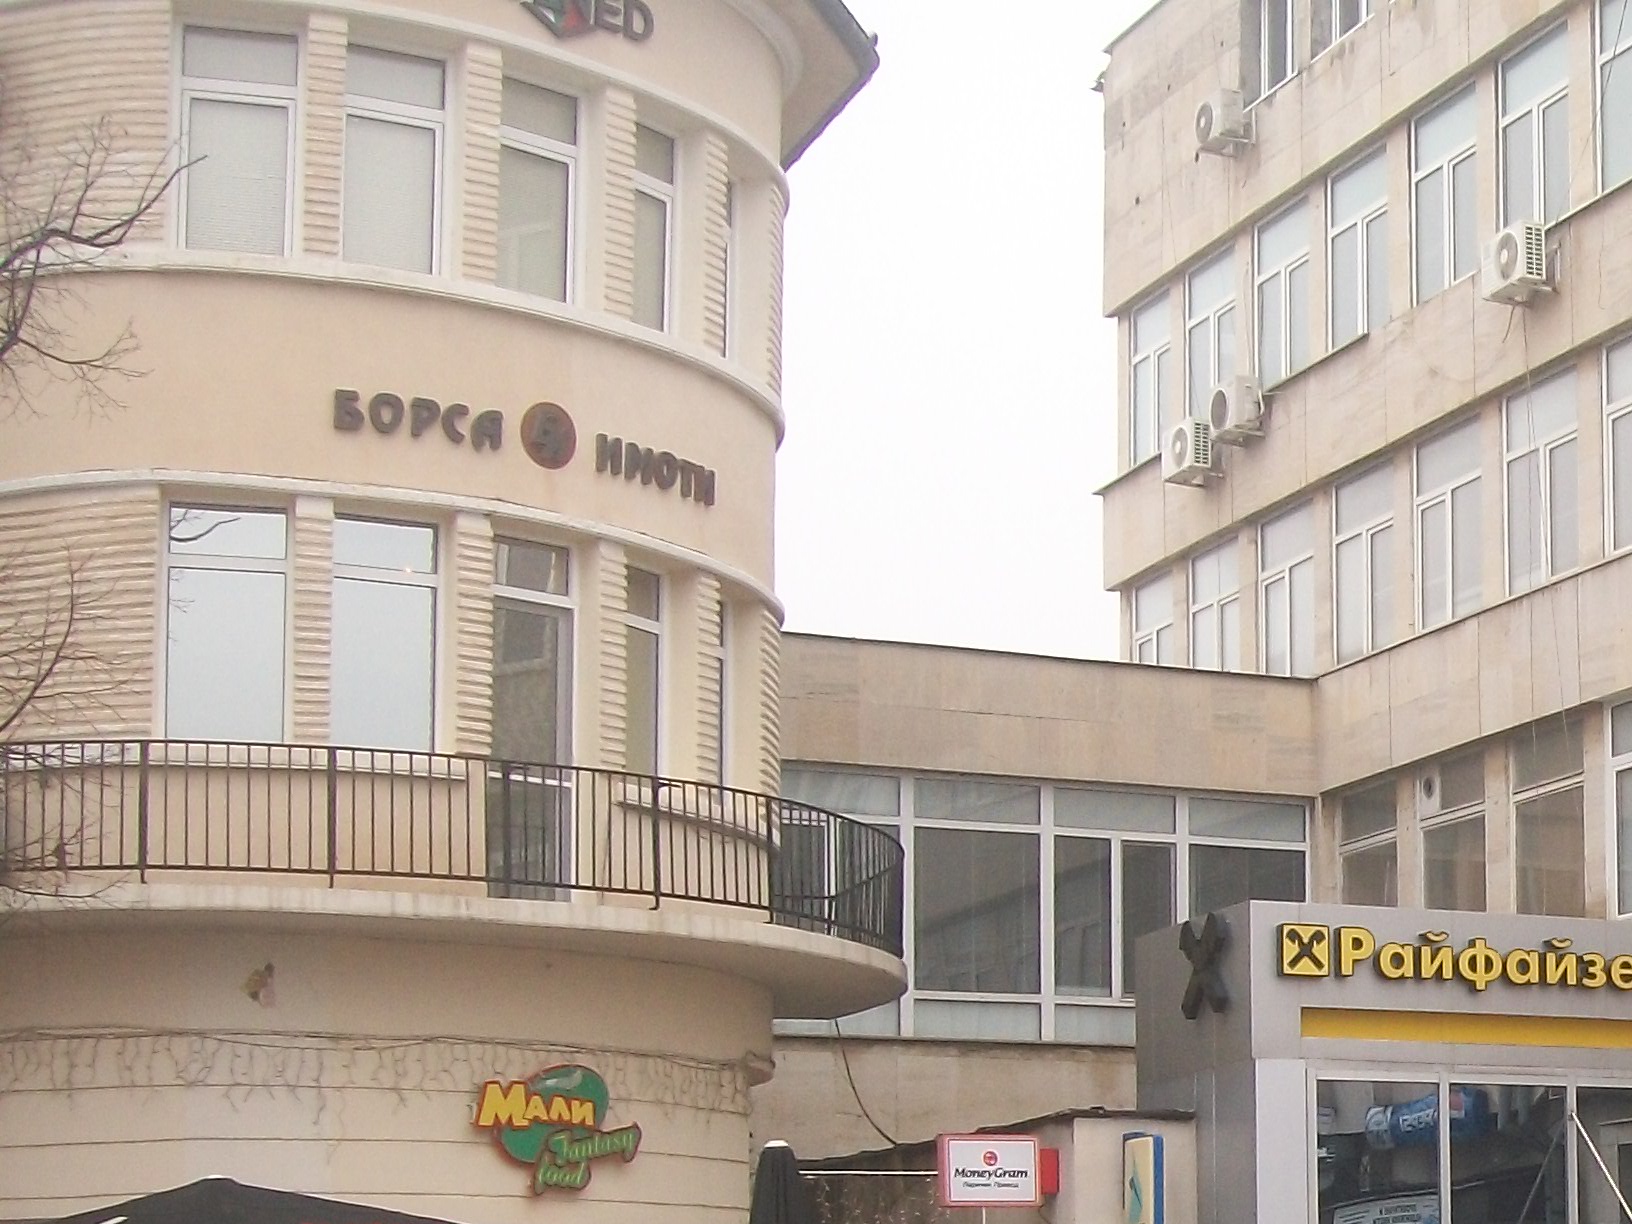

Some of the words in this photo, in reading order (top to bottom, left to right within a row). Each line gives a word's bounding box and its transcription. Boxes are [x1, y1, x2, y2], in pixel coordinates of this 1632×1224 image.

[333, 387, 504, 453] БОРСА
[595, 432, 717, 506] ИМОТИ
[954, 1166, 1029, 1181] MoneyGram
